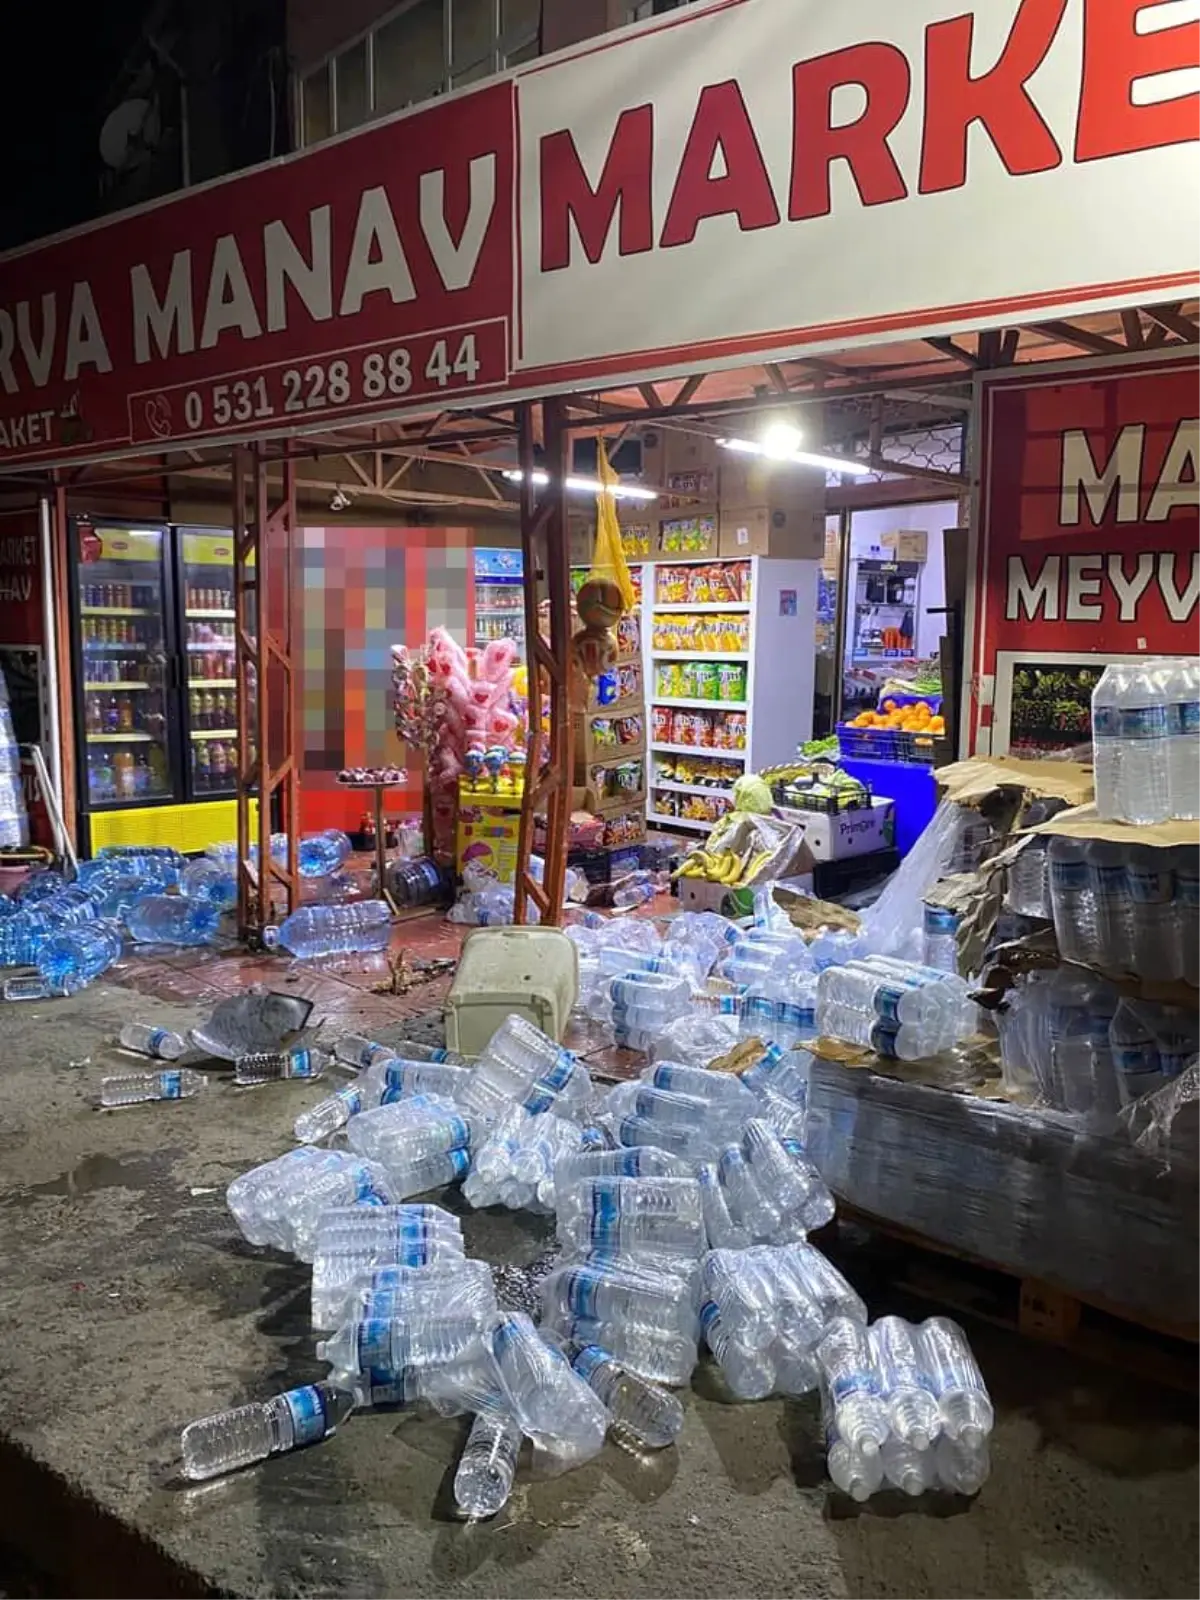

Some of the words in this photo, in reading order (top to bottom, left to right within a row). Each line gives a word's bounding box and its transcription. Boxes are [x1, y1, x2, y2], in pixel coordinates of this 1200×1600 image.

[130, 151, 498, 364] MANAV
[184, 391, 203, 430] 0
[212, 376, 275, 425] 531
[282, 360, 351, 413] 228
[362, 348, 412, 399] 88
[425, 333, 481, 387] 44
[1059, 416, 1200, 527] MA
[1004, 552, 1200, 622] MEYV
